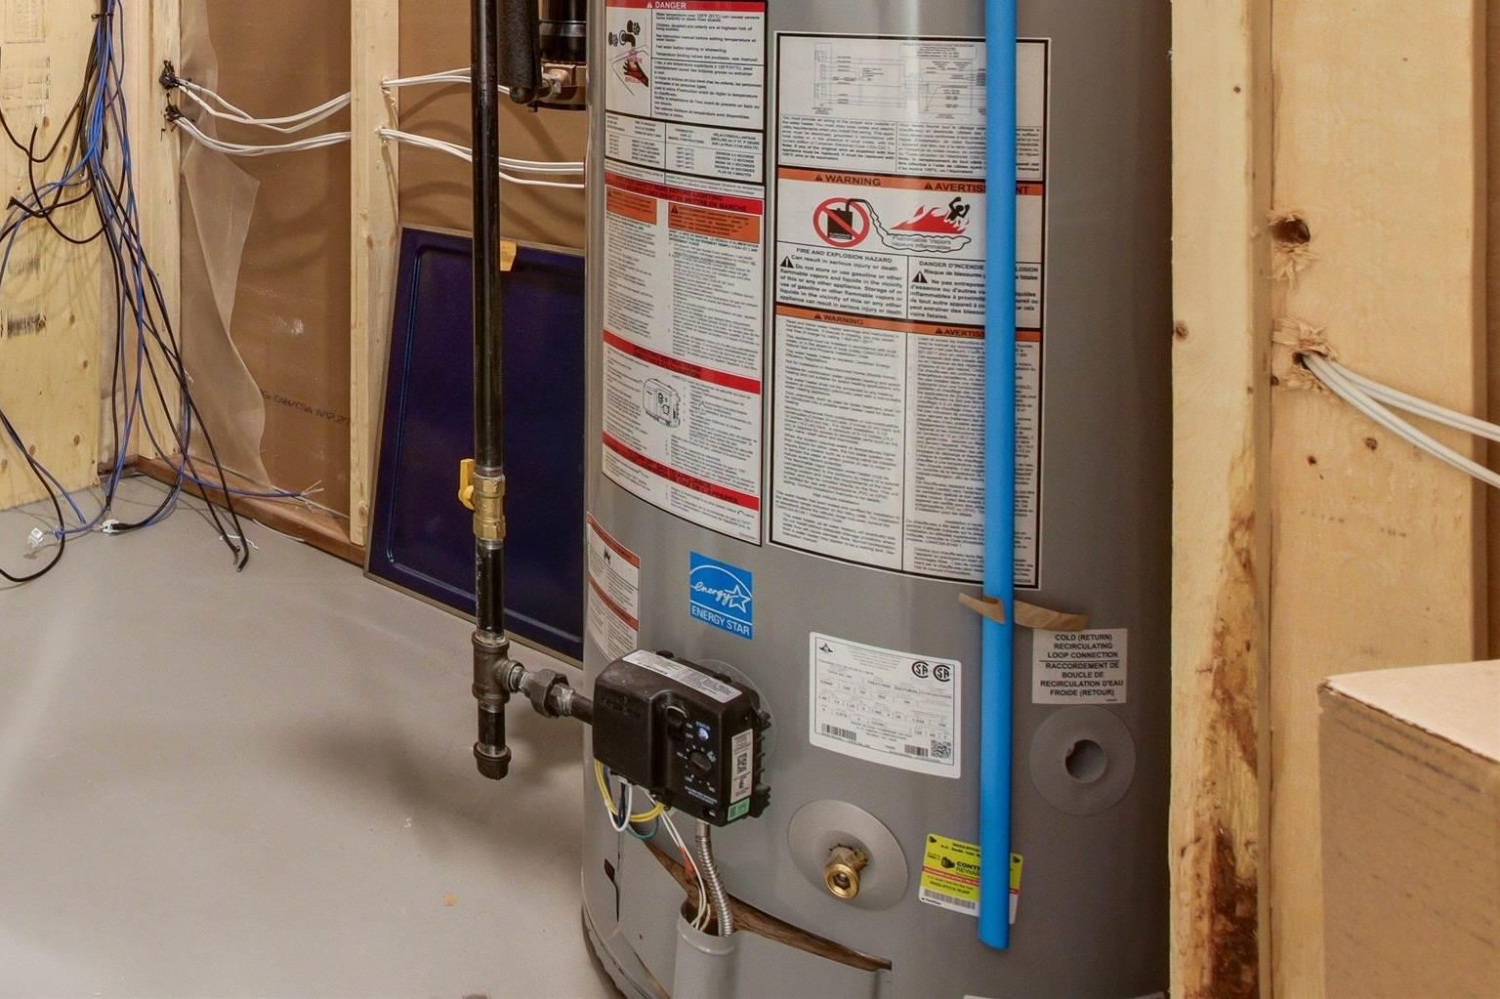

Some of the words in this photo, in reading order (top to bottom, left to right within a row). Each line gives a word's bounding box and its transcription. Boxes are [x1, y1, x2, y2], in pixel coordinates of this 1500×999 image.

[655, 1, 687, 9] DANGER
[825, 174, 880, 186] WARNING
[938, 183, 1028, 194] AVERTISNT
[826, 251, 863, 260] EXPLOSION
[780, 268, 808, 277] flammable
[810, 272, 828, 280] vapors
[842, 275, 861, 284] liquids
[852, 270, 876, 278] gasoline
[824, 314, 863, 324] WARNING
[945, 329, 985, 338] AVERTIS
[692, 581, 730, 606] energy
[692, 606, 725, 626] ENERGY
[726, 620, 750, 636] STAR
